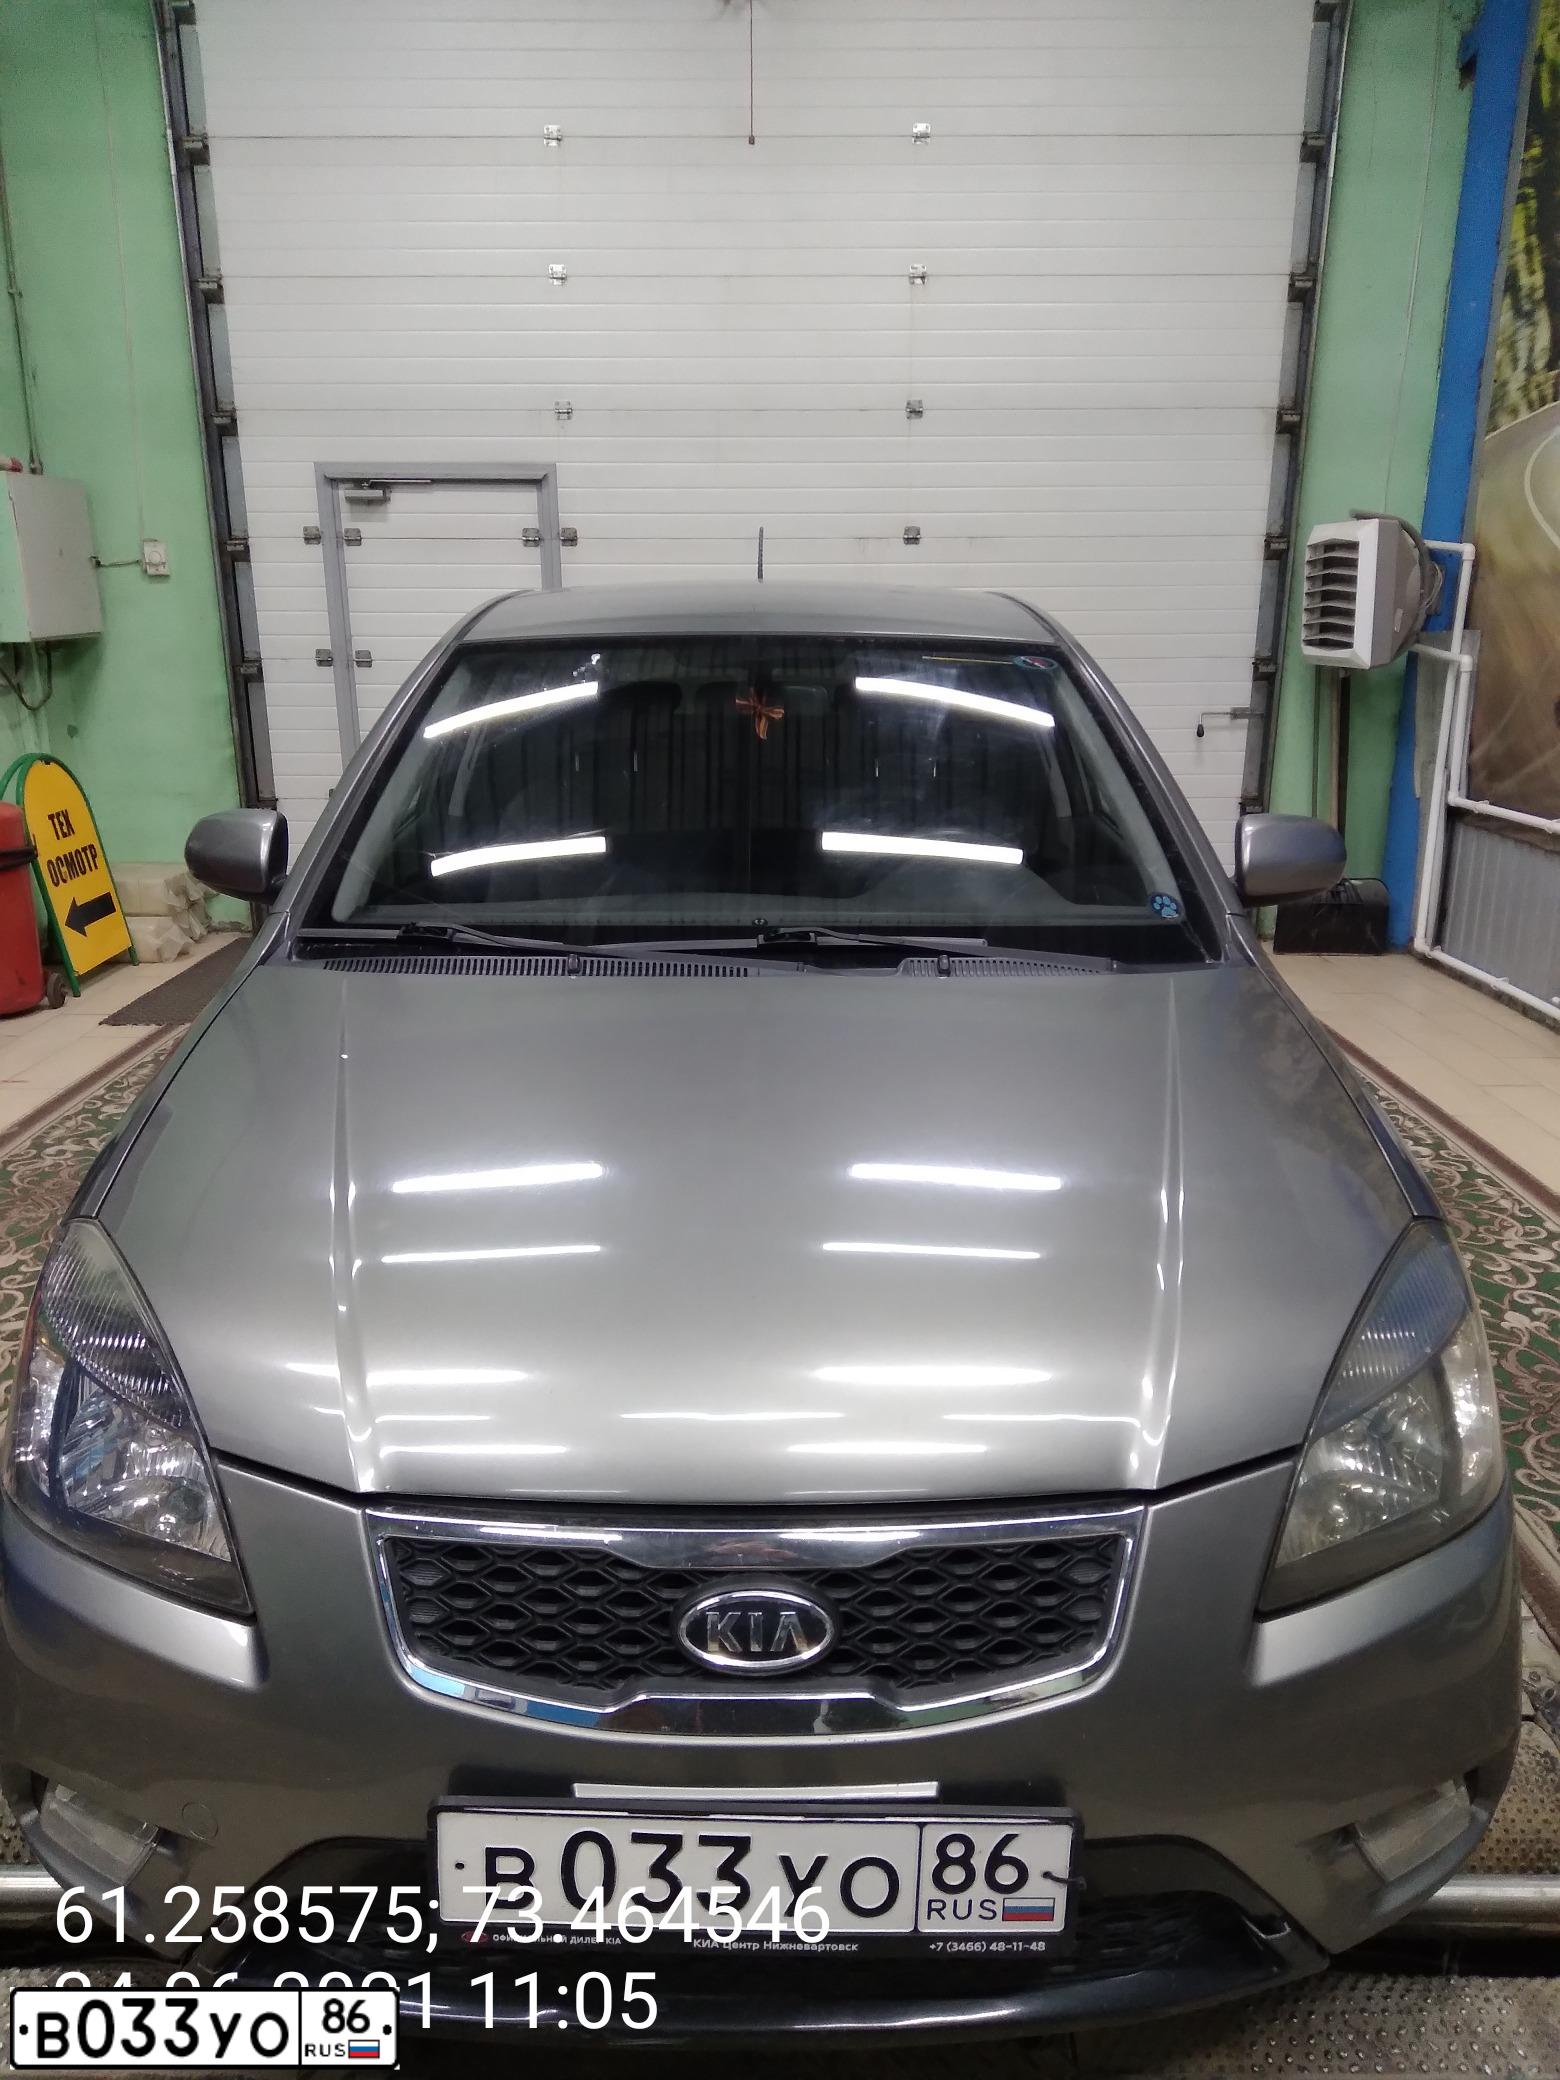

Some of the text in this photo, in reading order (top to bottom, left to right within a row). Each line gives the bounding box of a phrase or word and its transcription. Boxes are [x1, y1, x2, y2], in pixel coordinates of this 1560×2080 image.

[48, 809, 75, 840] ТЕХ
[47, 843, 99, 888] ОСМОТР
[706, 1611, 810, 1652] KIA
[931, 1833, 1029, 1895] 86
[926, 1898, 998, 1921] RUS
[693, 1938, 720, 1949] КИА
[763, 1940, 859, 1951] Нижневартовск
[929, 1941, 1046, 1953] +7 (3466) 48-11-48
